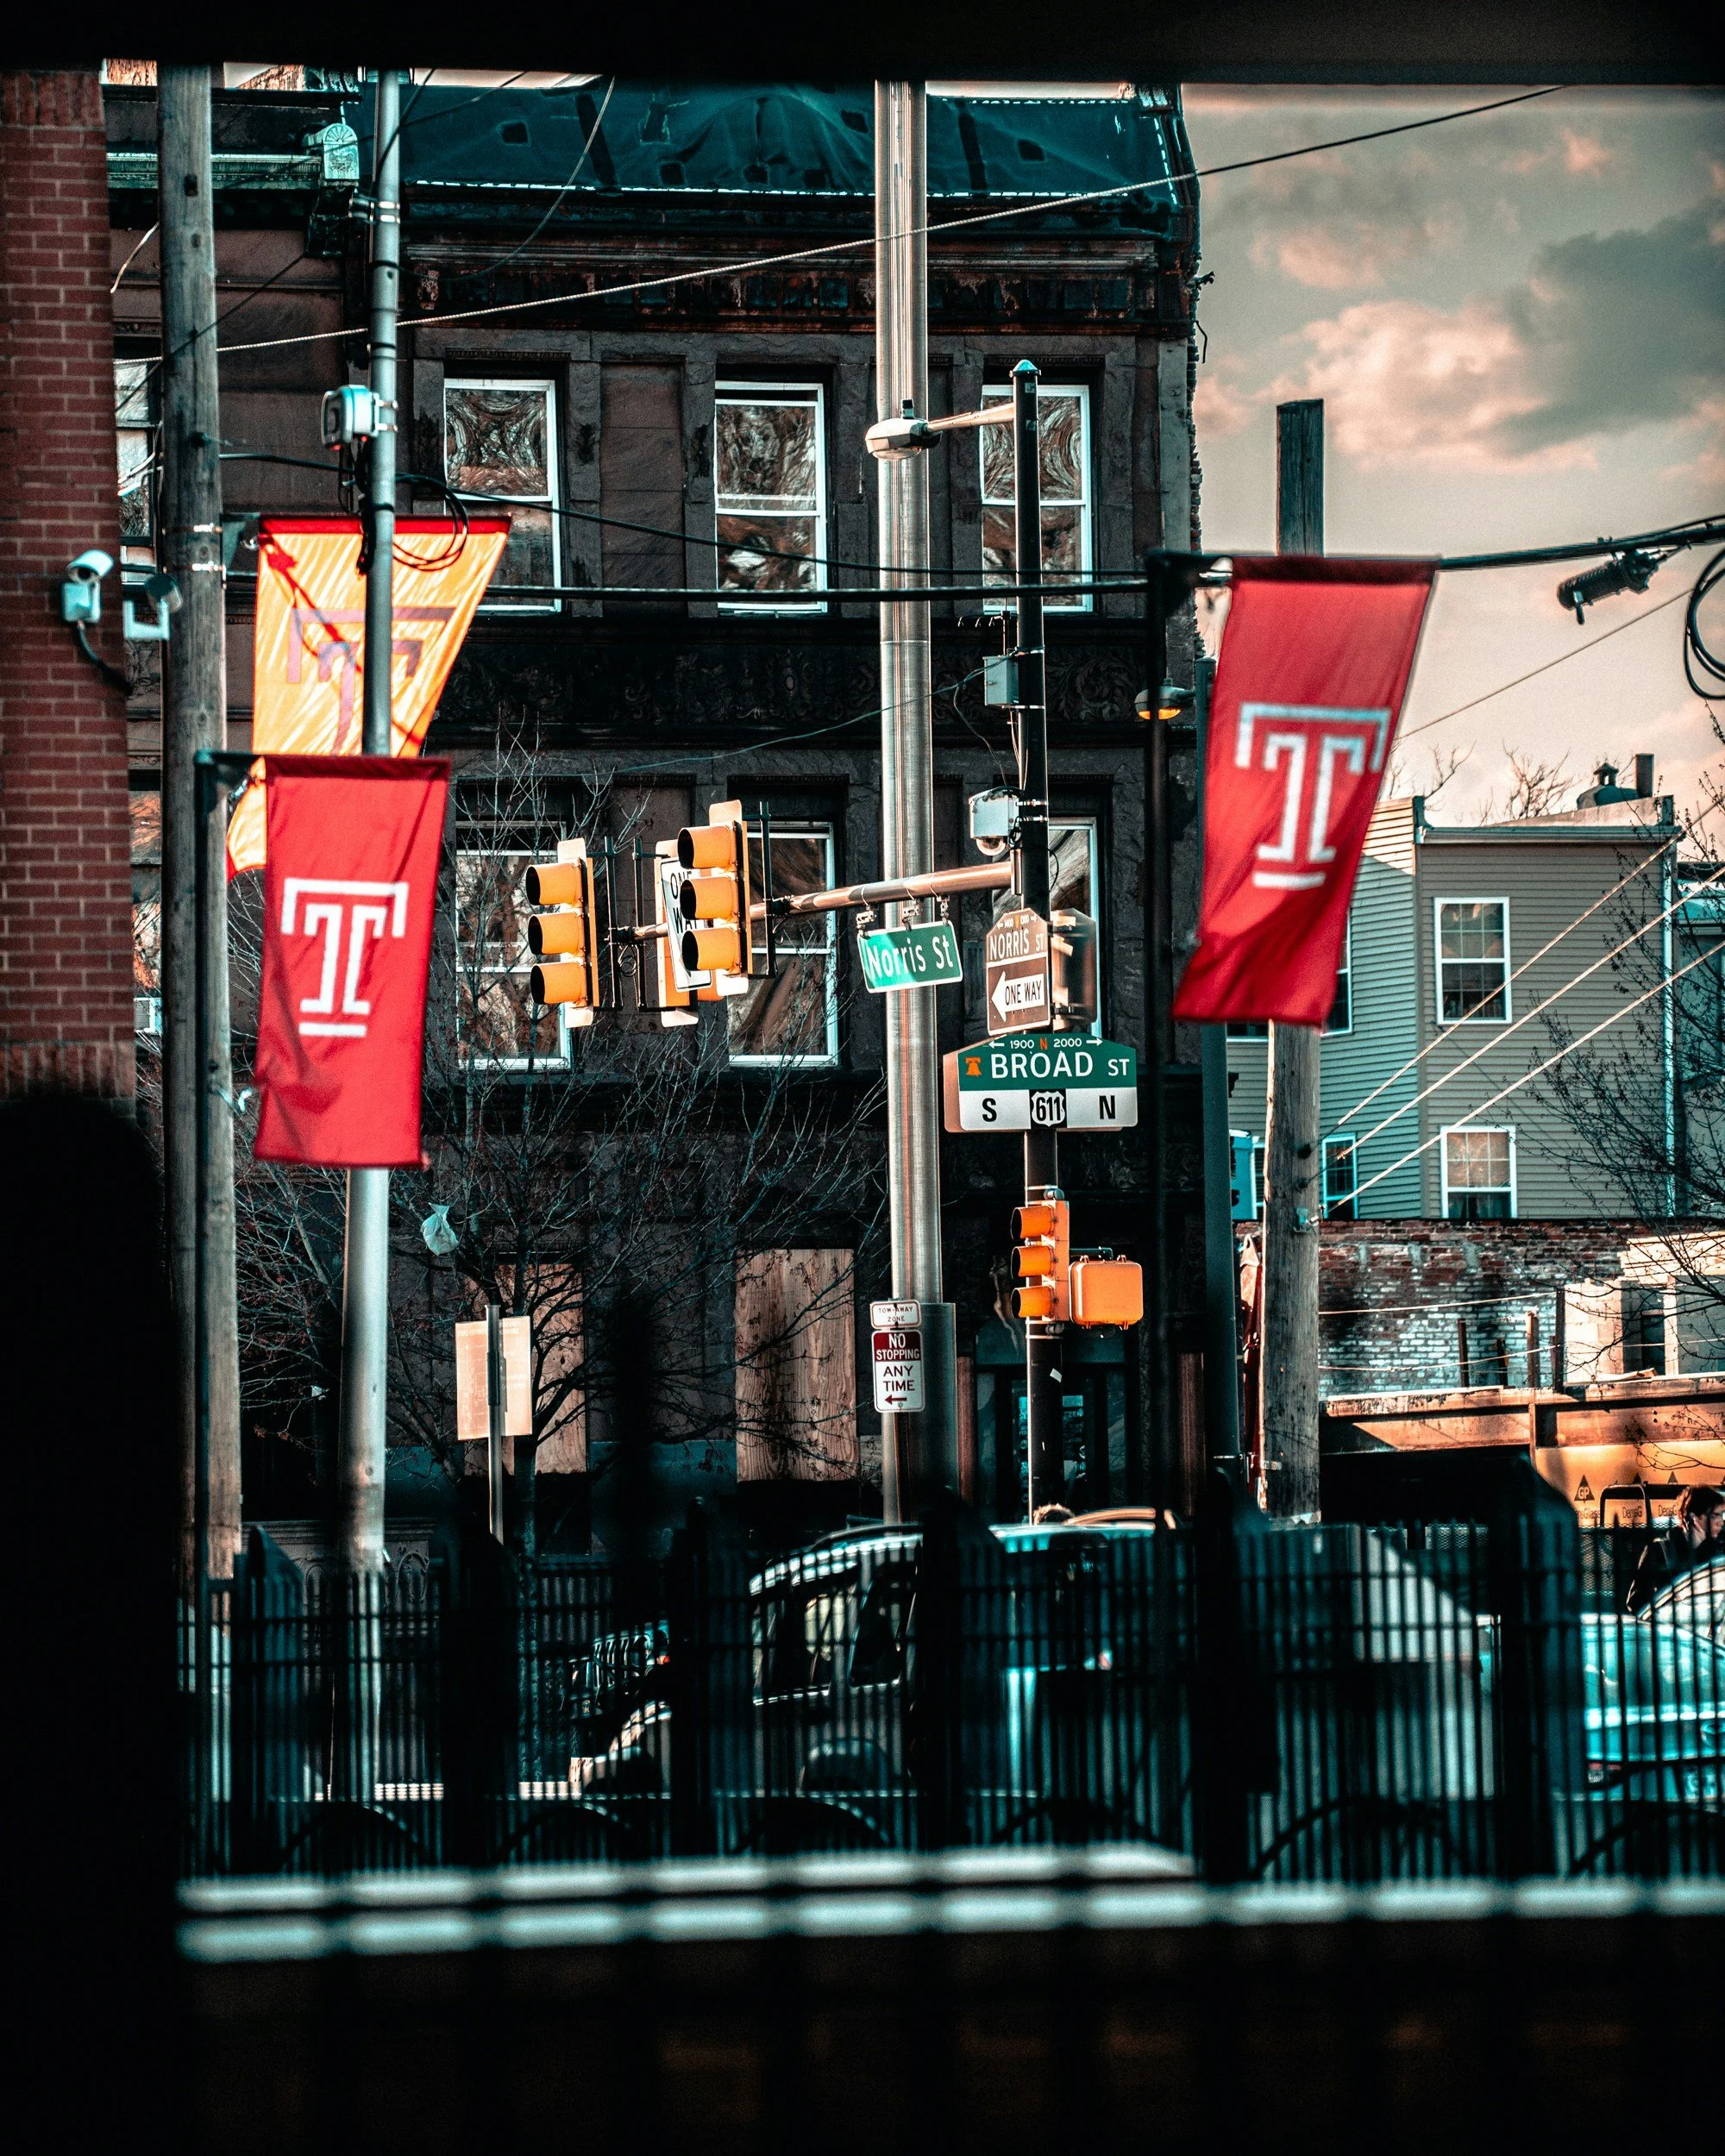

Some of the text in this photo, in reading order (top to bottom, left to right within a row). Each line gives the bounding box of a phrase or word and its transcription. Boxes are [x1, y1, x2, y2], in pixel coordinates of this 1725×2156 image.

[1234, 700, 1392, 891] T
[989, 928, 1044, 961] NORRIS ST
[280, 877, 409, 1037] T
[866, 934, 954, 981] Norris St
[1005, 980, 1041, 1006] ONE WAY
[1010, 1037, 1082, 1050] 1900 N 2000
[991, 1051, 1130, 1079] BROAD ST
[982, 1094, 1116, 1122] S 611 N
[888, 1333, 906, 1349] NO
[875, 1348, 920, 1361] STOPPING
[883, 1365, 914, 1377] ANY
[883, 1380, 916, 1392] TIME
[1578, 1486, 1590, 1500] GP
[1622, 1505, 1643, 1519] DensG
[1658, 1504, 1678, 1518] DensG
